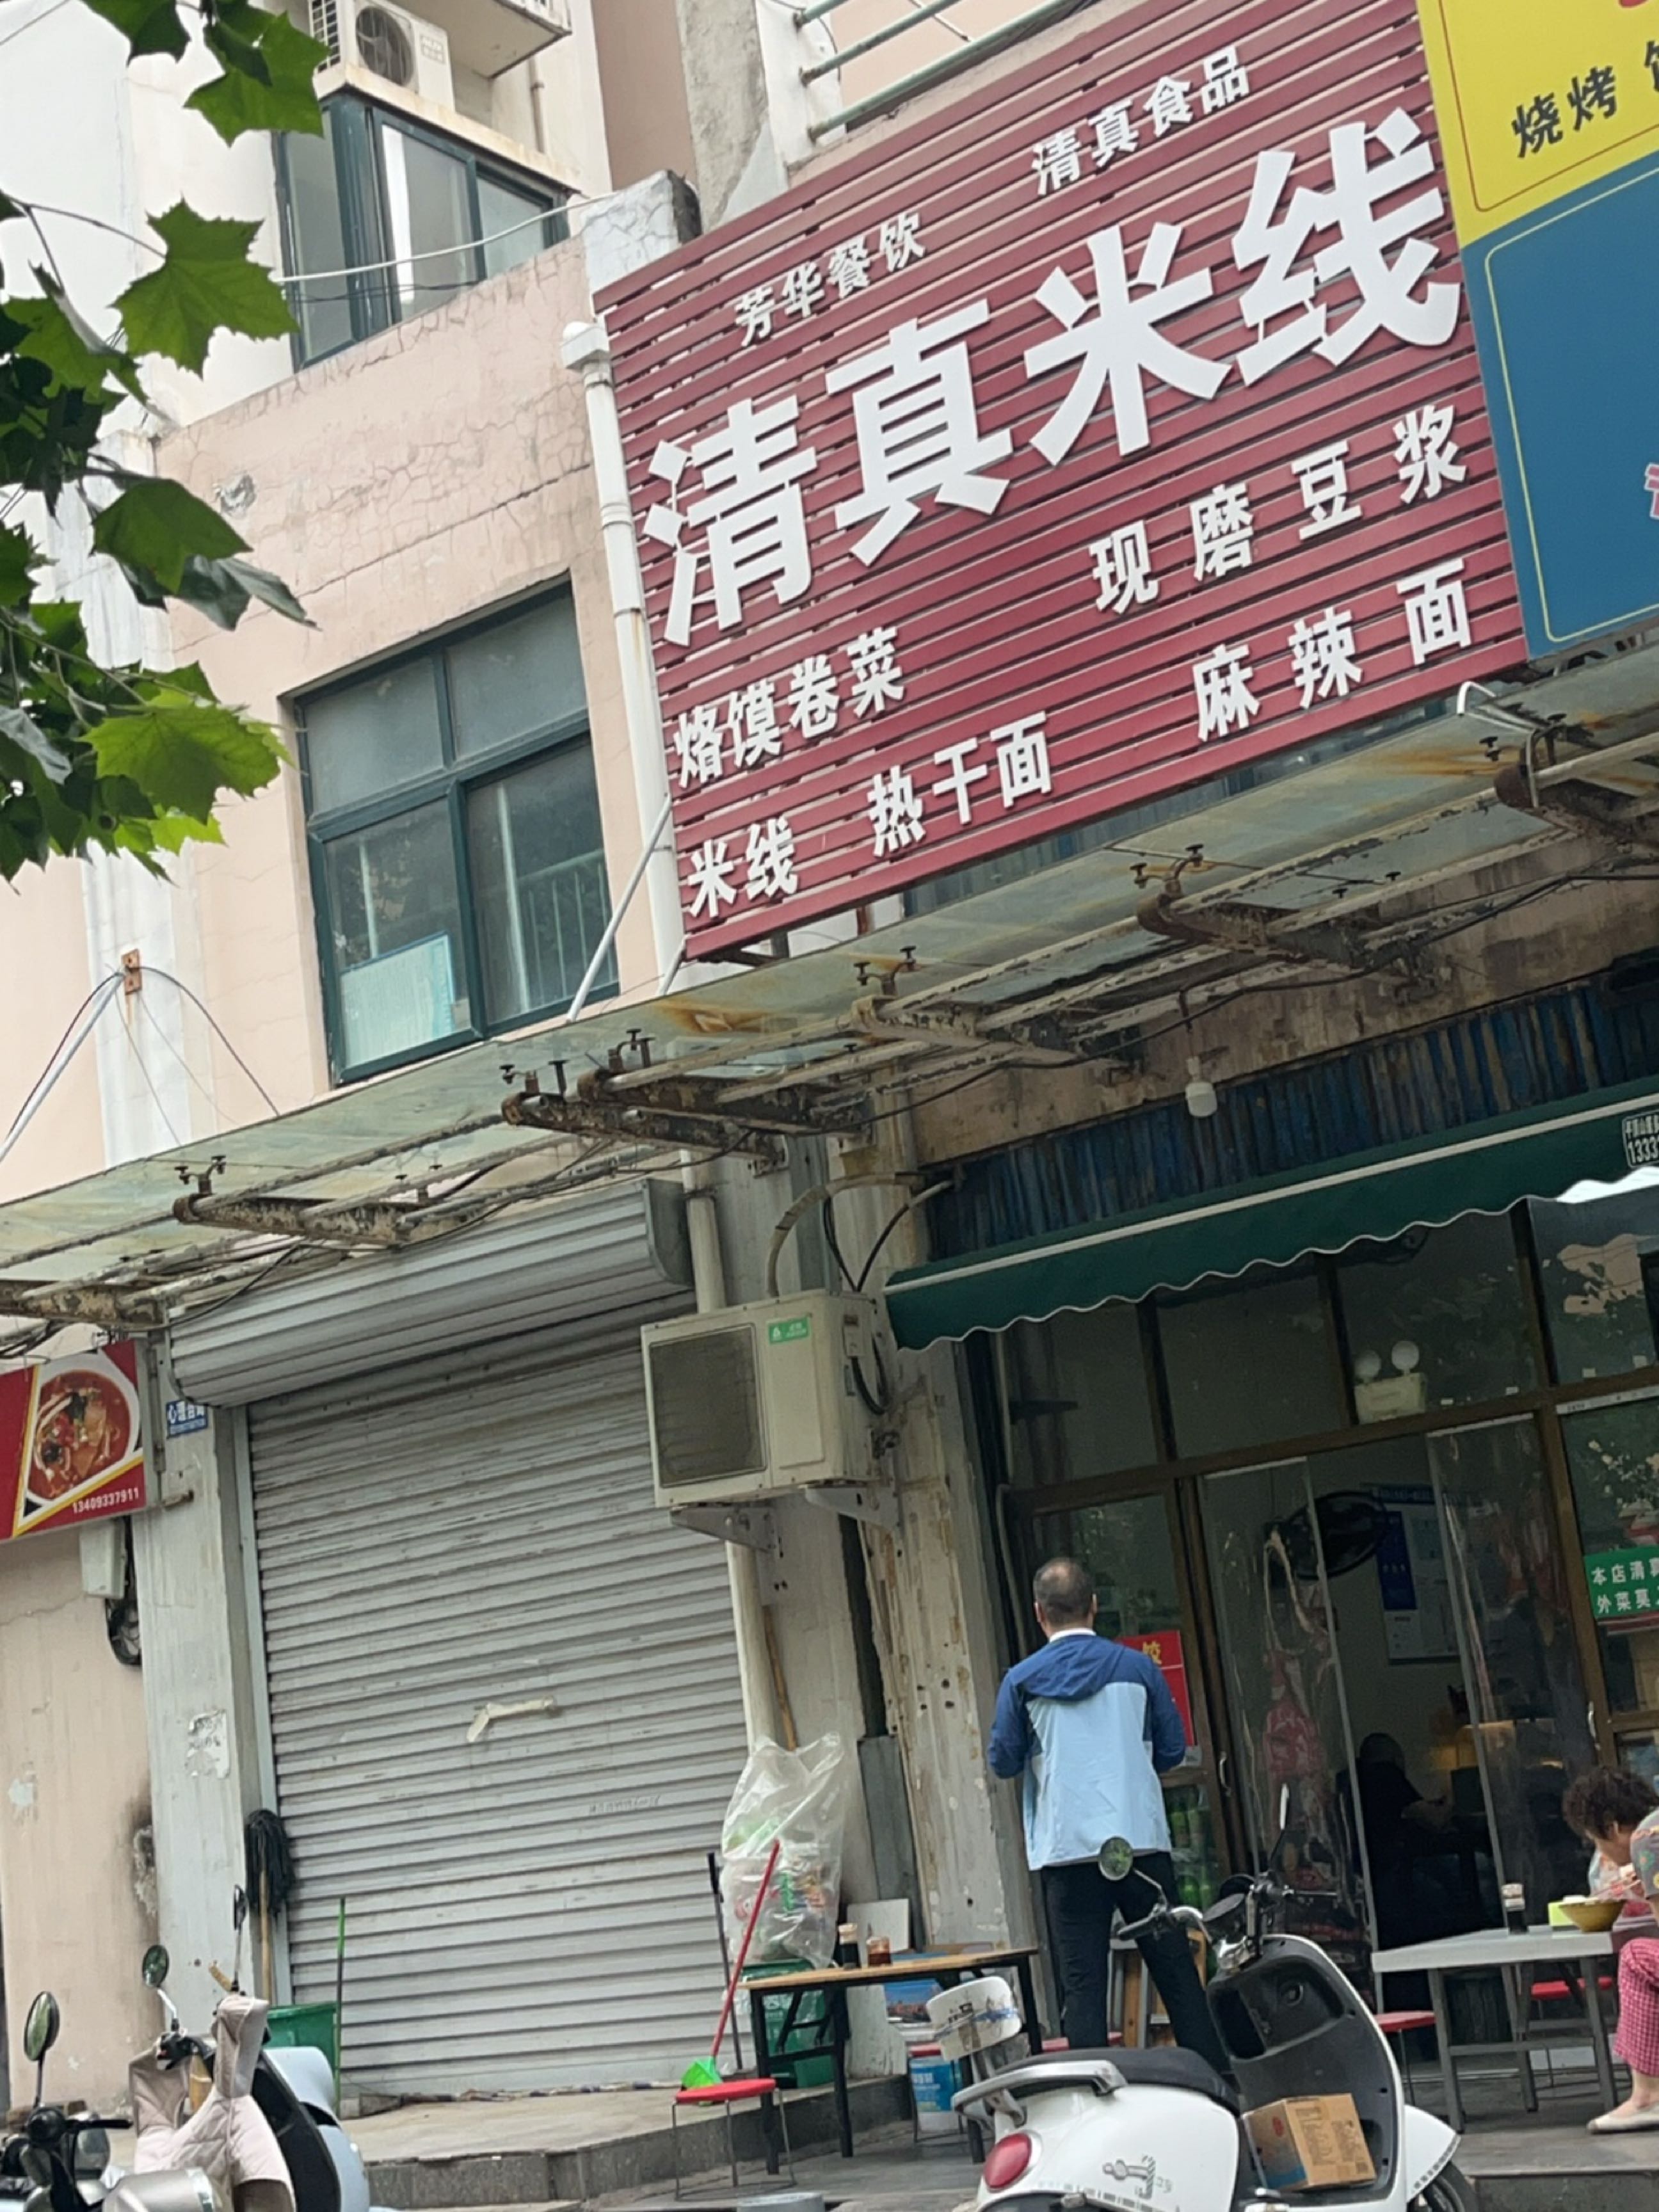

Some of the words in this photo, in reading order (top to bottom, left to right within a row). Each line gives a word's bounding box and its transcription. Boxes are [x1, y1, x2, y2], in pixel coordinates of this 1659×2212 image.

[1032, 45, 1249, 195] 清真食品
[1511, 65, 1617, 159] 烧烤
[733, 212, 926, 347] 芳华餐饮
[643, 107, 1462, 646] 清真米线
[1089, 405, 1466, 615] 现磨豆浆
[673, 627, 905, 788] 烙馍卷菜
[1192, 558, 1472, 742] 麻辣面
[867, 712, 1052, 858] 热干面
[687, 817, 799, 918] 米线
[1598, 1586, 1659, 1614] 外菜莫
